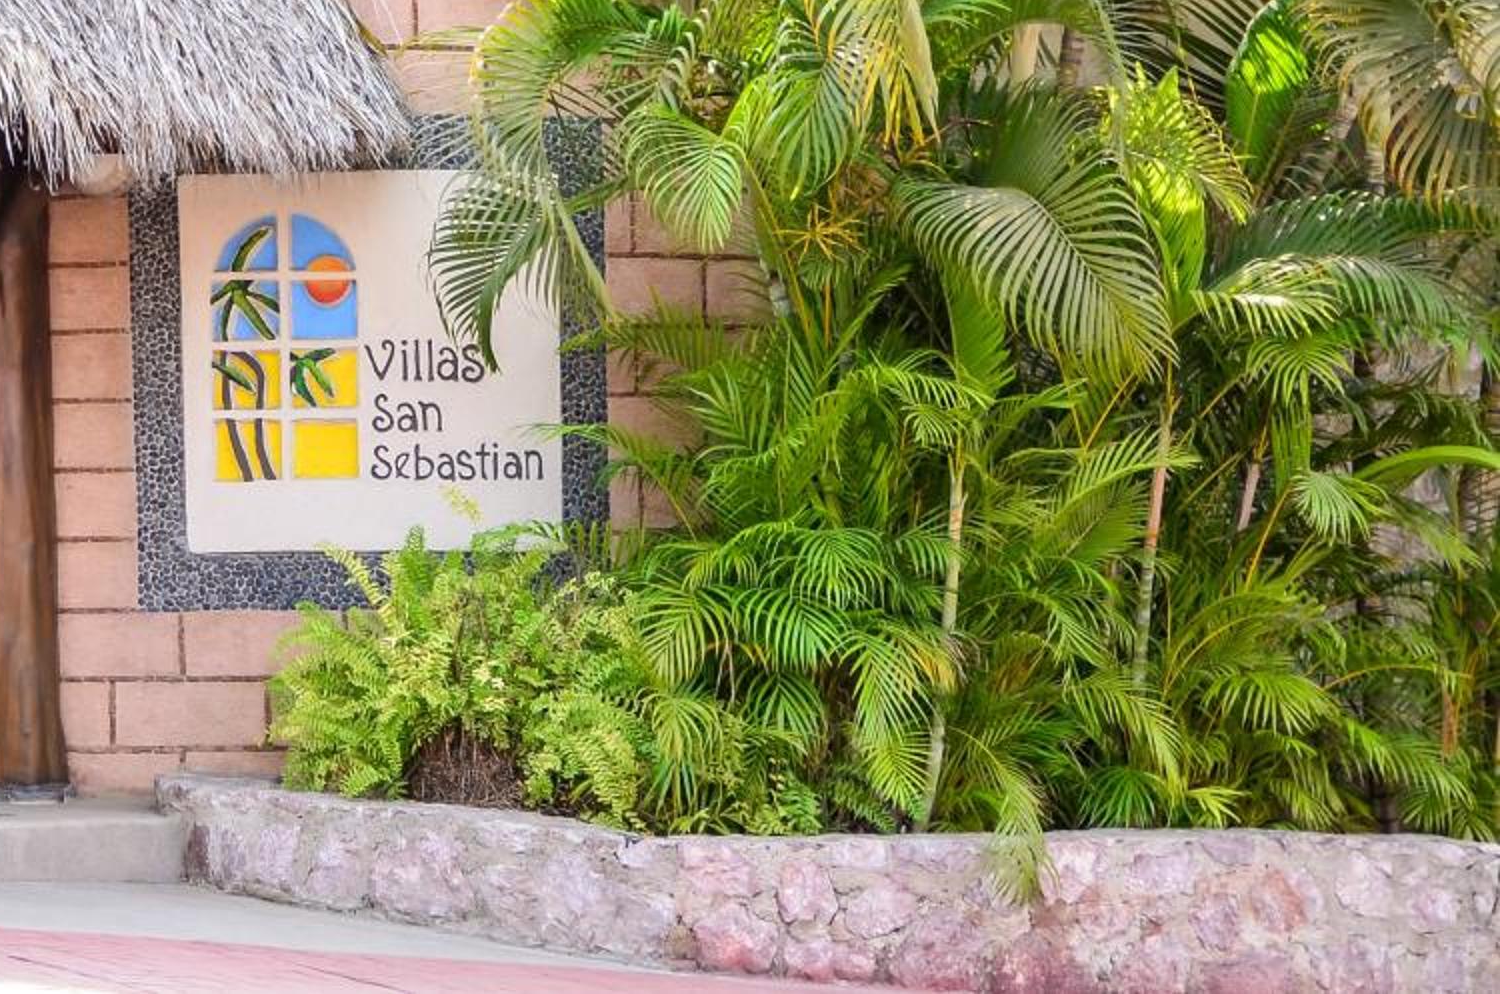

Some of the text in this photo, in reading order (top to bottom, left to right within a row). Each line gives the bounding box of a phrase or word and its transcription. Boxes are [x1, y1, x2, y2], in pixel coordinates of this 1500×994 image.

[364, 339, 485, 383] Villas
[372, 393, 443, 432] San
[371, 443, 544, 482] Sebastian
